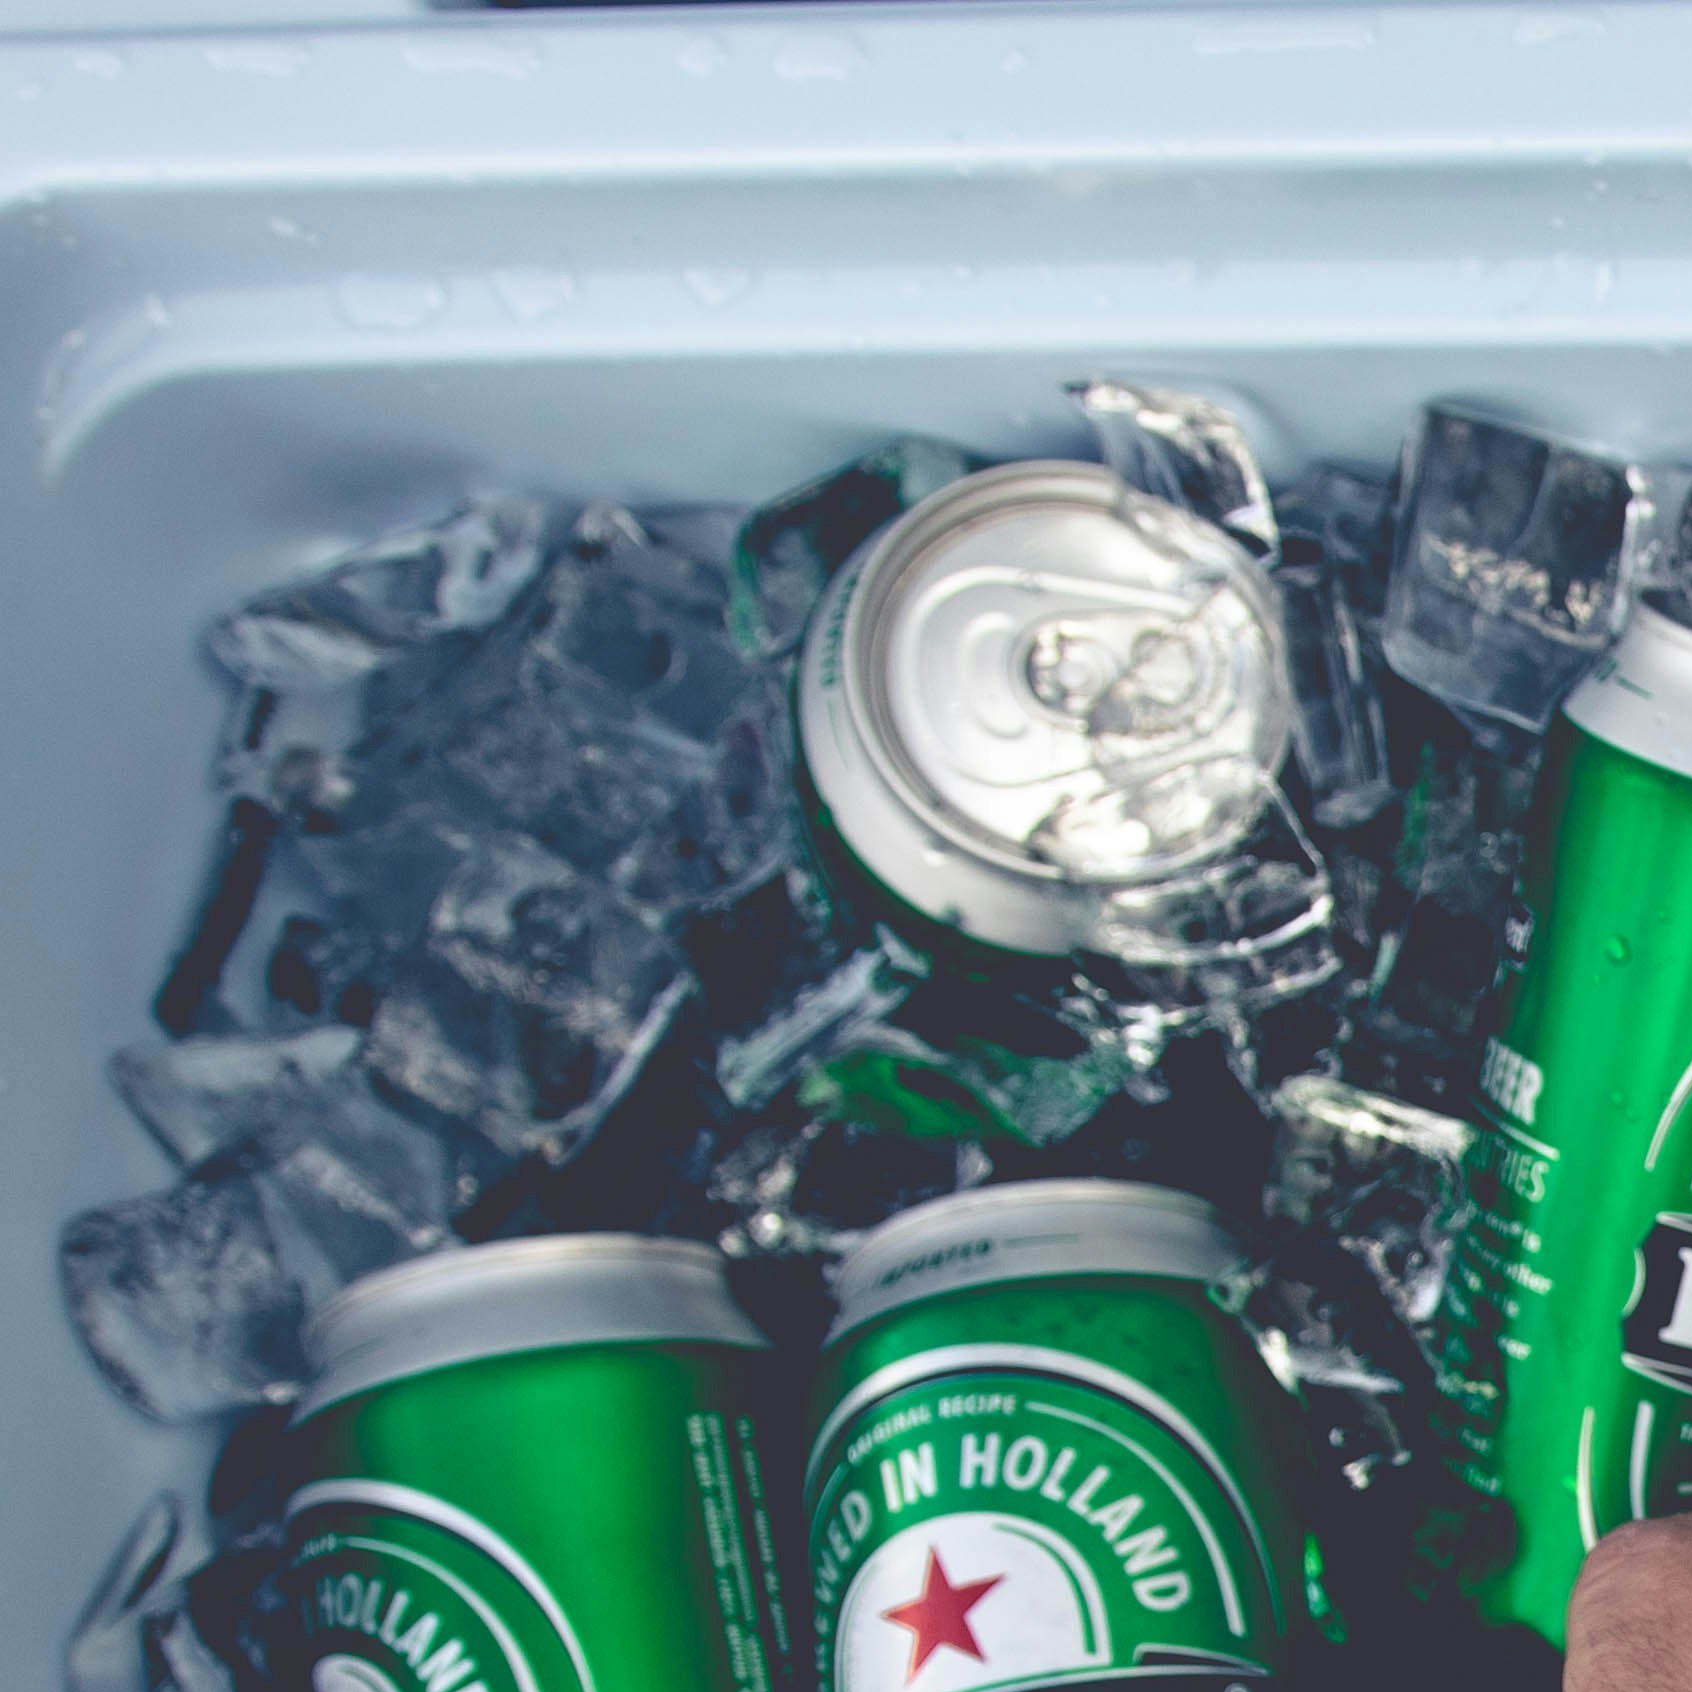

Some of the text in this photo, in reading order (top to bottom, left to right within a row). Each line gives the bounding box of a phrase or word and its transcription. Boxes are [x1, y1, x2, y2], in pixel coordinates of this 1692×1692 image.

[845, 1391, 1018, 1465] ORIGINAL RECIPE
[879, 1441, 939, 1513] IN
[958, 1432, 1193, 1613] HOLLAND
